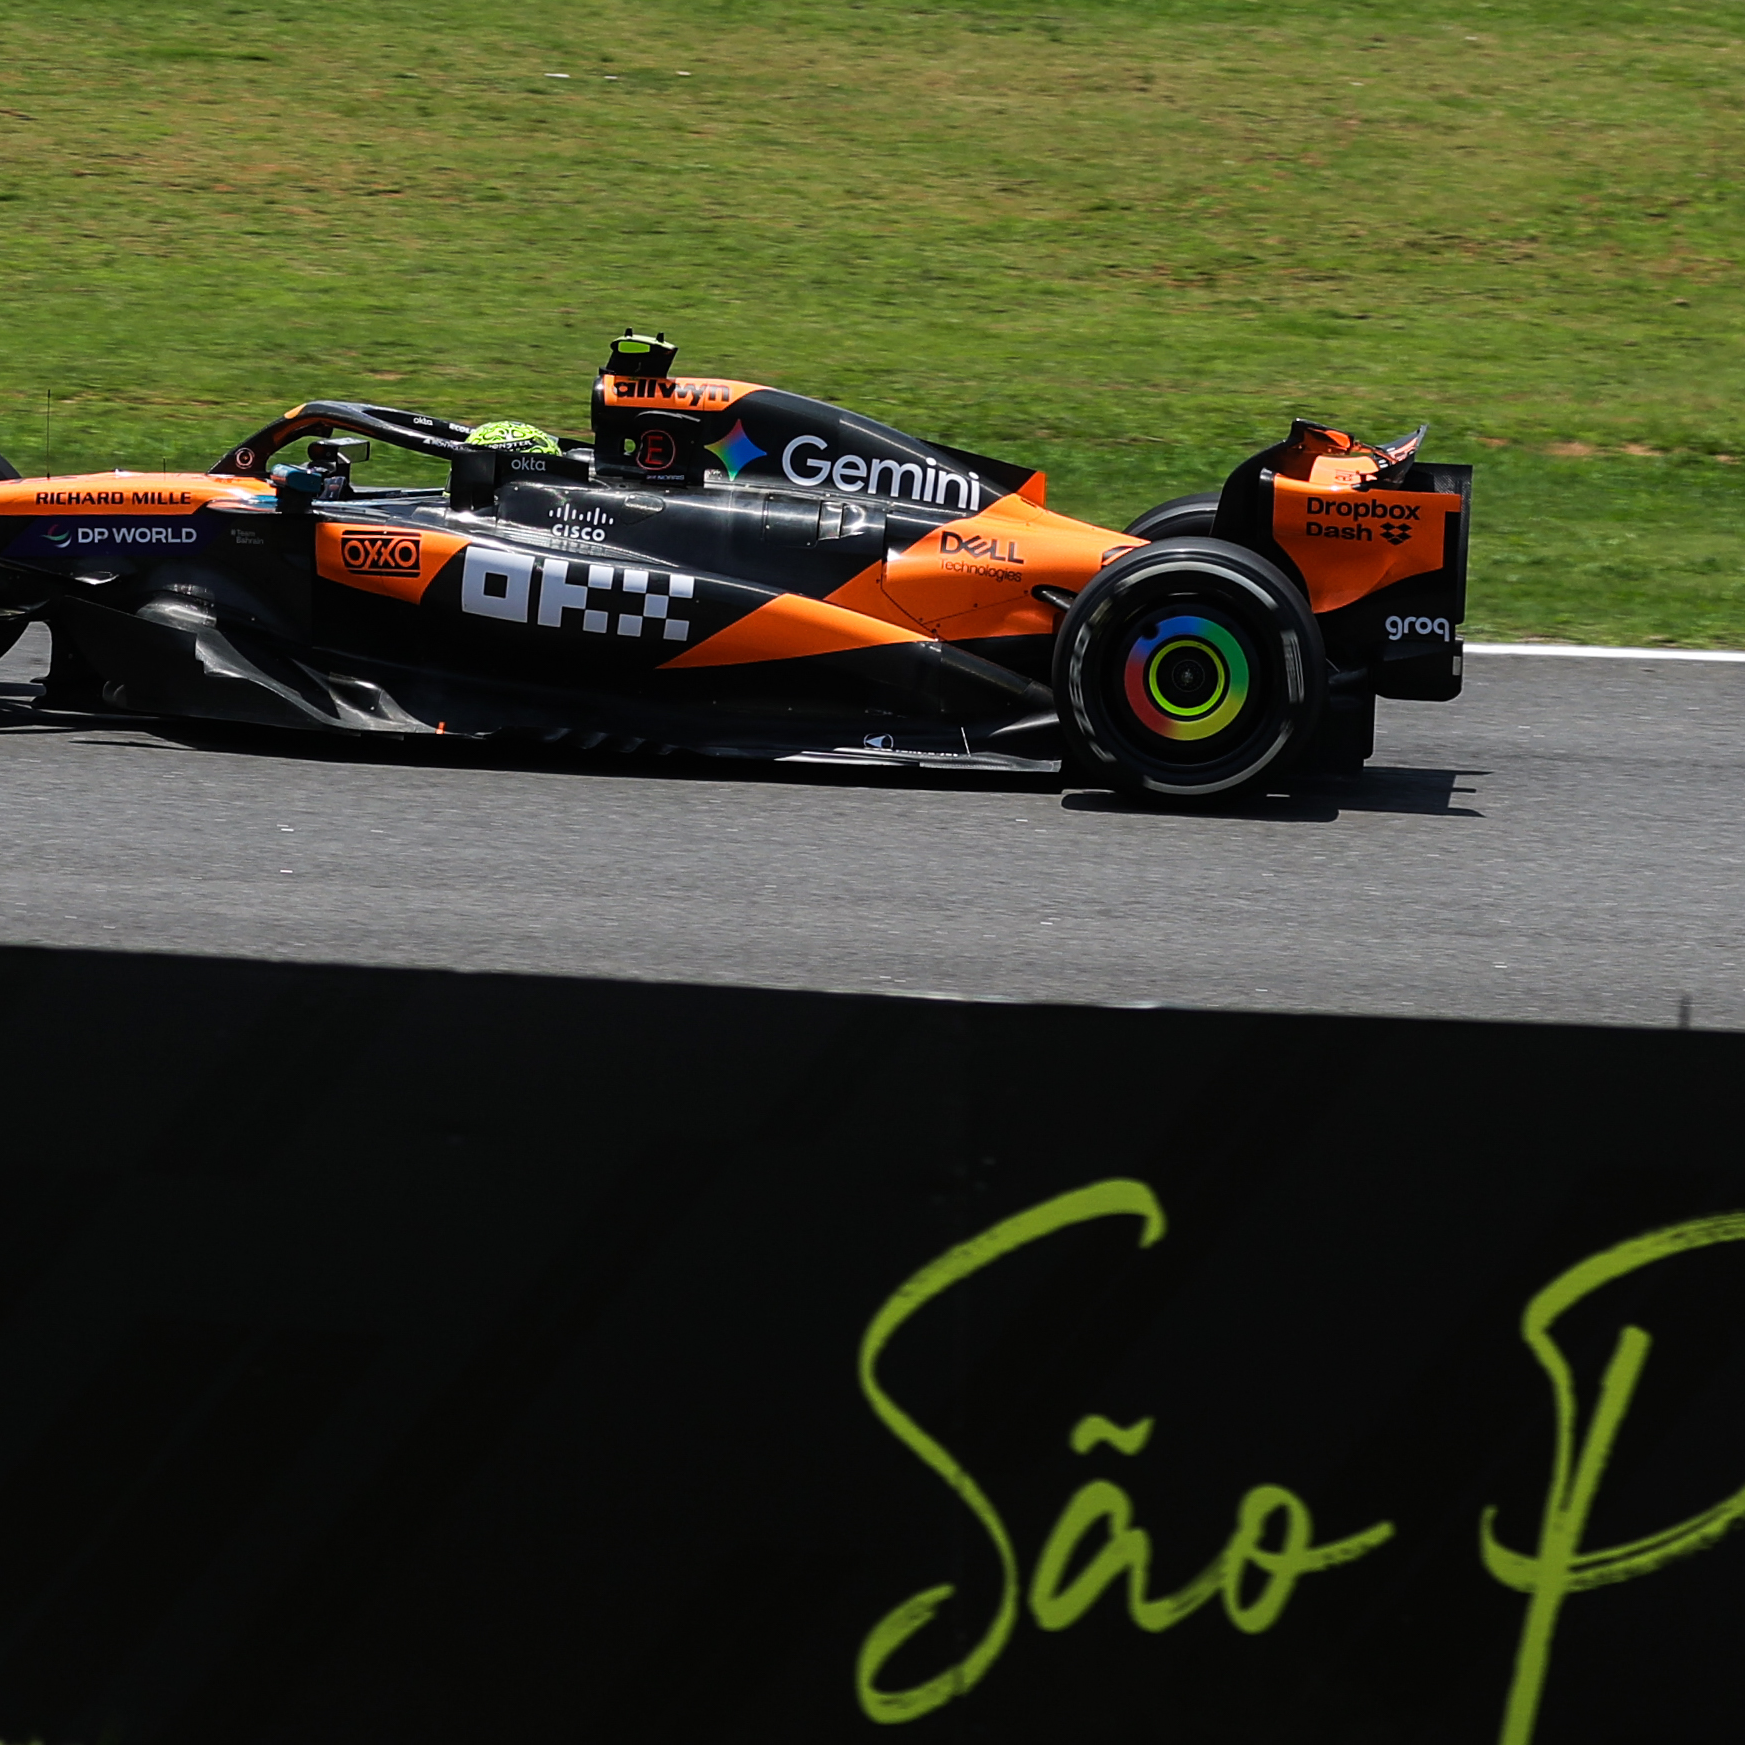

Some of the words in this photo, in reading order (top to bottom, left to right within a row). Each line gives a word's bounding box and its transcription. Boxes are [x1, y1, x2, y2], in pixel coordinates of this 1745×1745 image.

[613, 379, 730, 406] allwyn
[413, 416, 433, 425] okta
[511, 457, 546, 472] okta
[781, 434, 981, 511] Gemini
[35, 491, 125, 505] RICHARD
[131, 491, 192, 505] MILLE
[1306, 496, 1421, 521] Dropbox
[77, 527, 109, 544] DP
[112, 527, 197, 544] WORLD
[1305, 521, 1373, 542] Dash
[343, 538, 419, 569] OXXO
[939, 530, 1025, 565] DELL
[939, 558, 1023, 583] Technologies
[461, 546, 695, 641] OKX
[1385, 615, 1450, 643] groq
[856, 1177, 1396, 1725] São
